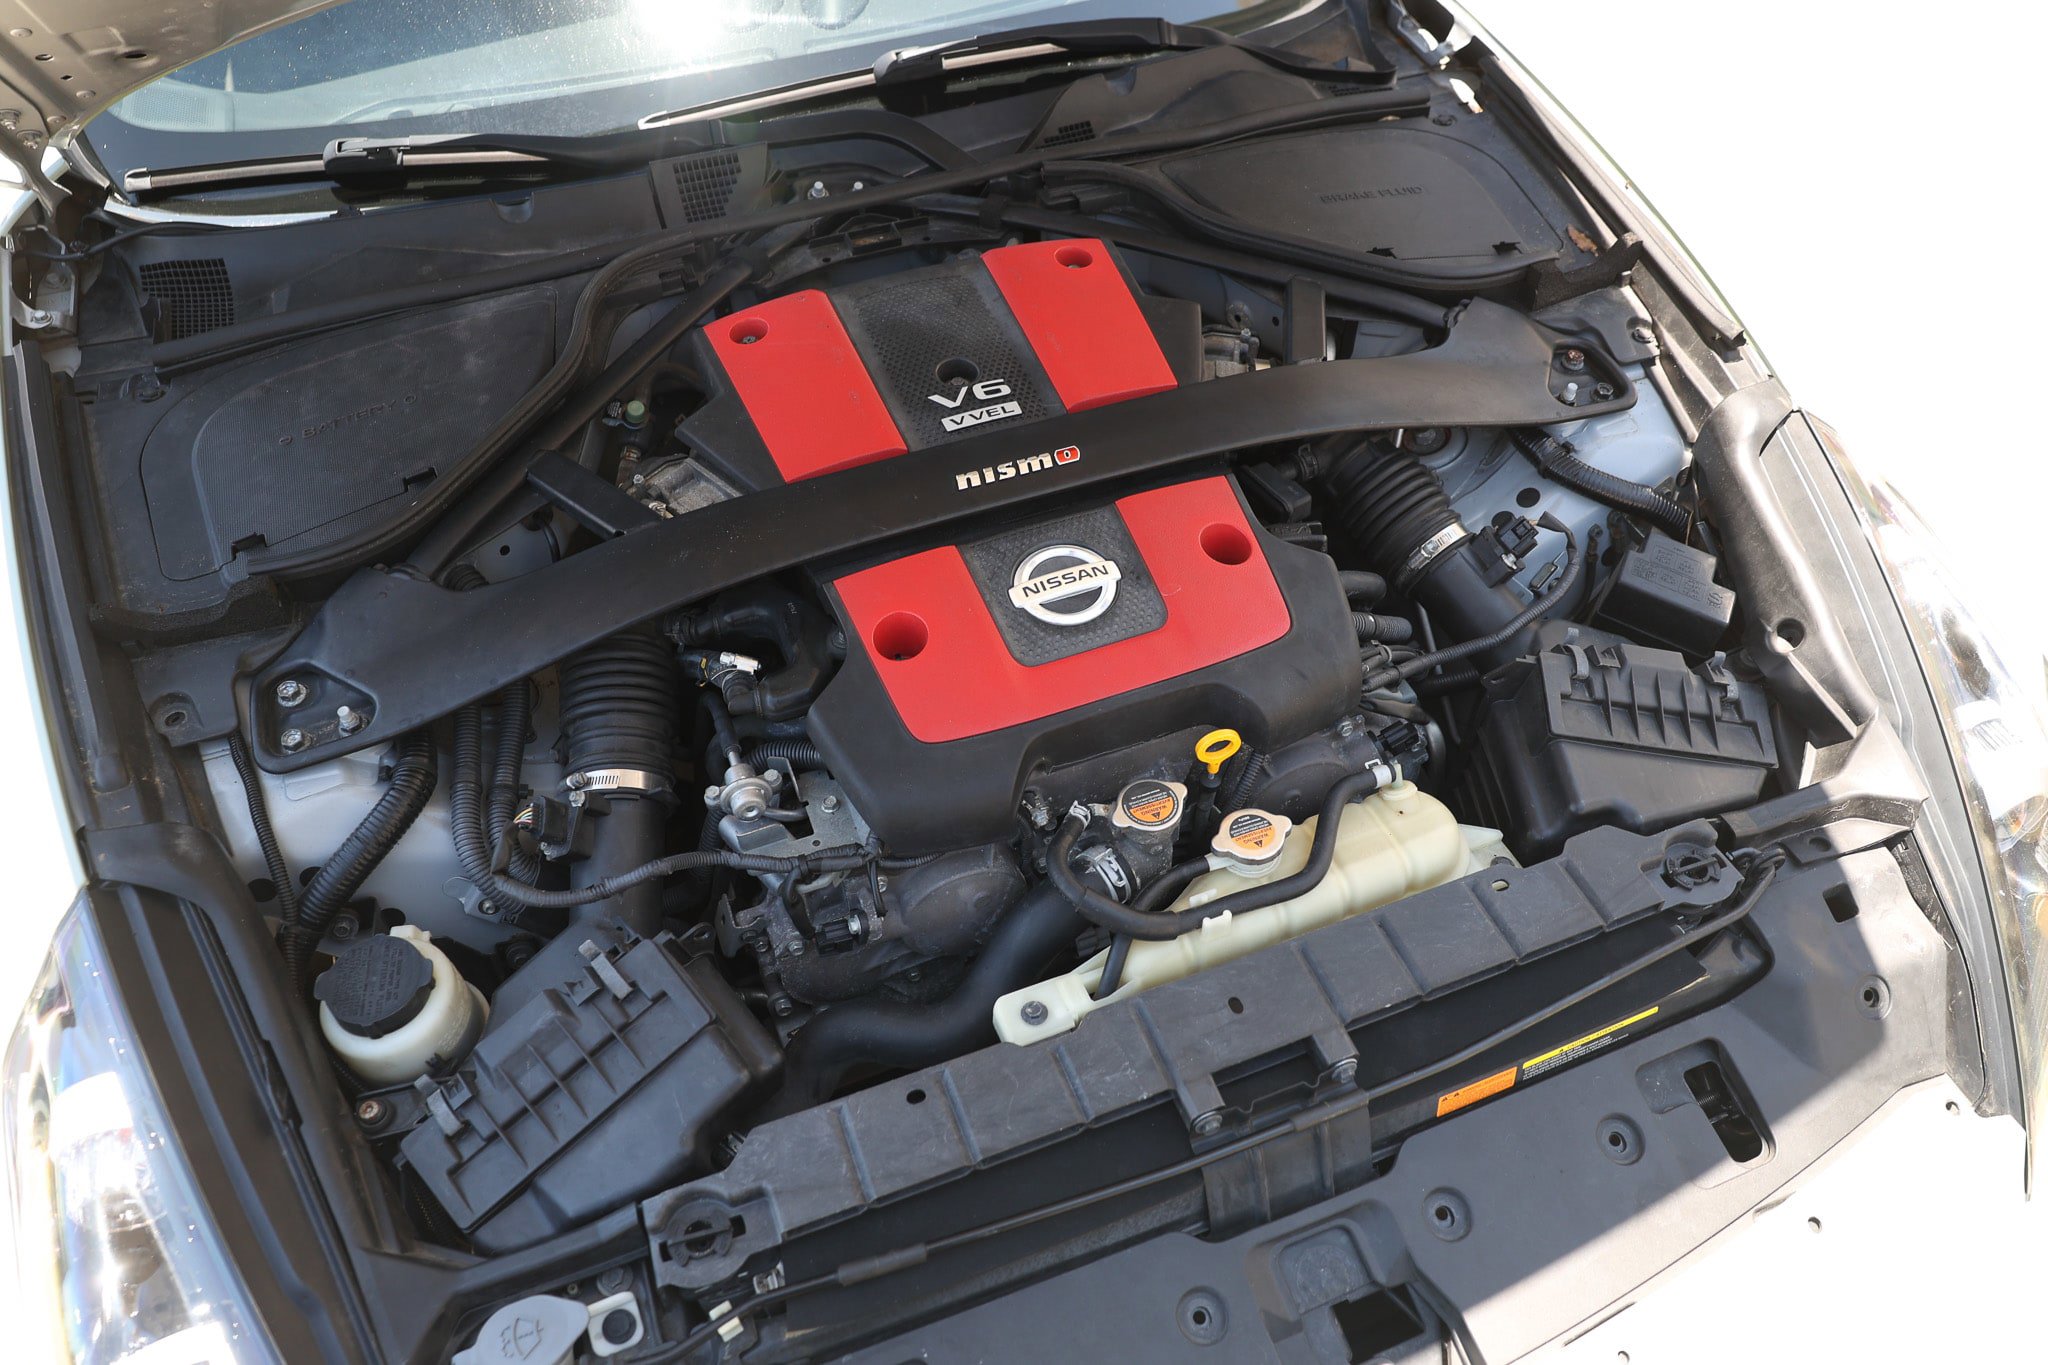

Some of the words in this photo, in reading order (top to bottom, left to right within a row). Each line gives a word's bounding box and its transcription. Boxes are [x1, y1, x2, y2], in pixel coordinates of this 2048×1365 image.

[928, 378, 1012, 409] V6
[302, 399, 397, 438] BATTERY
[949, 403, 1015, 426] VVEL
[1022, 564, 1109, 598] NISSAN
[1141, 804, 1168, 816] WARNING
[1243, 832, 1269, 845] WARNING
